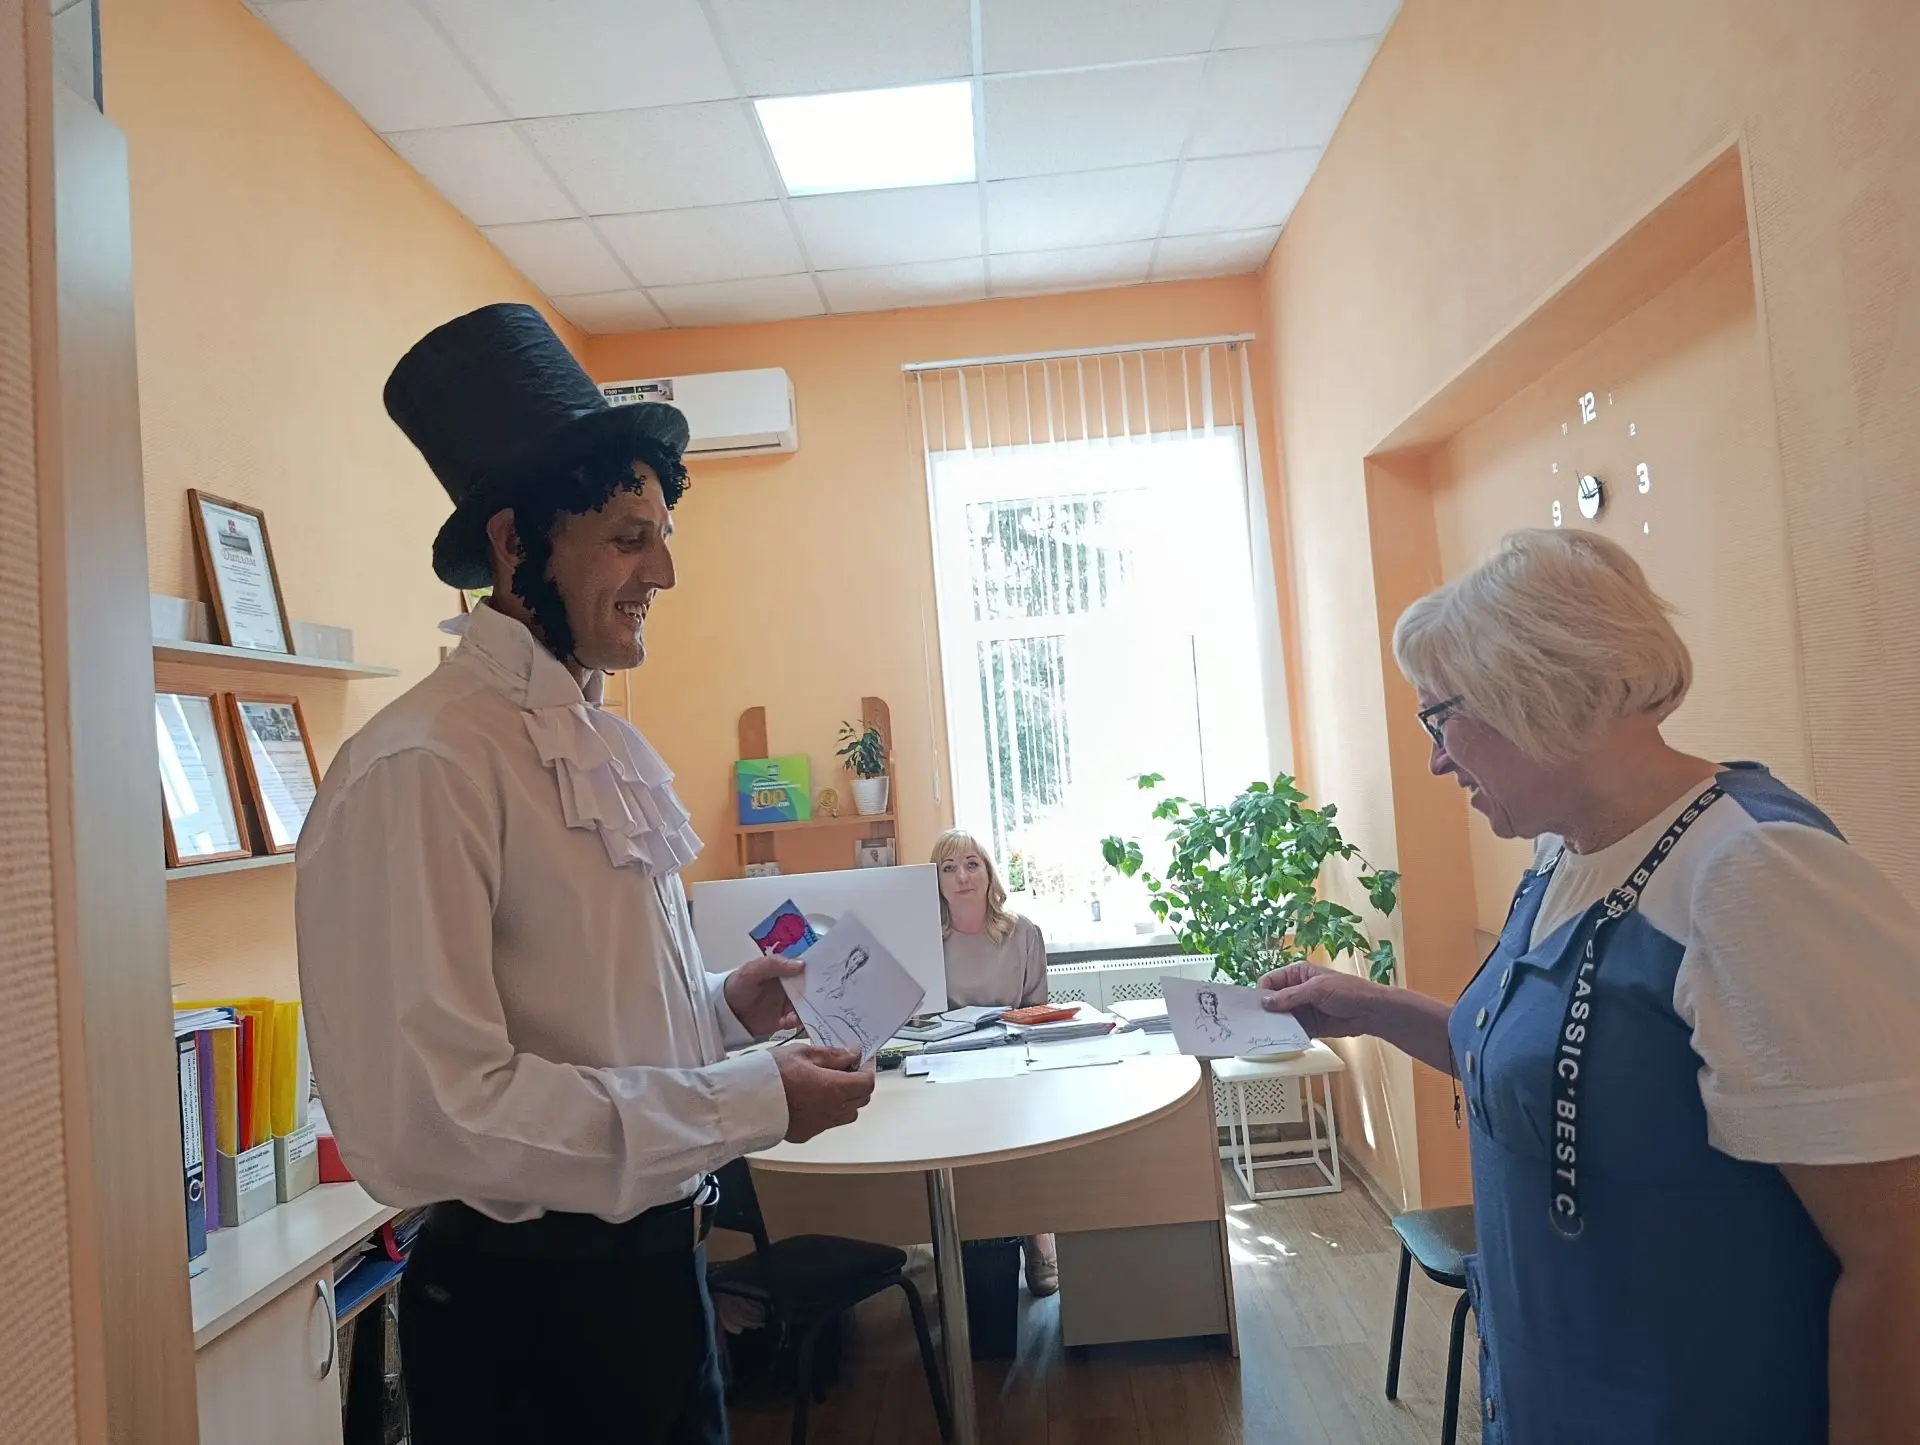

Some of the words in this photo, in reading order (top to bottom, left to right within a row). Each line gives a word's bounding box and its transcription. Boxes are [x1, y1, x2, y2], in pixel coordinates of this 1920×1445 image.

[1579, 391, 1597, 425] 12
[1629, 422, 1637, 436] 2
[1636, 462, 1650, 494] 3
[1552, 500, 1562, 528] 9
[1659, 786, 1720, 853] SSIC
[1558, 939, 1594, 1081] CLASSIC
[1557, 1099, 1577, 1187] BEST
